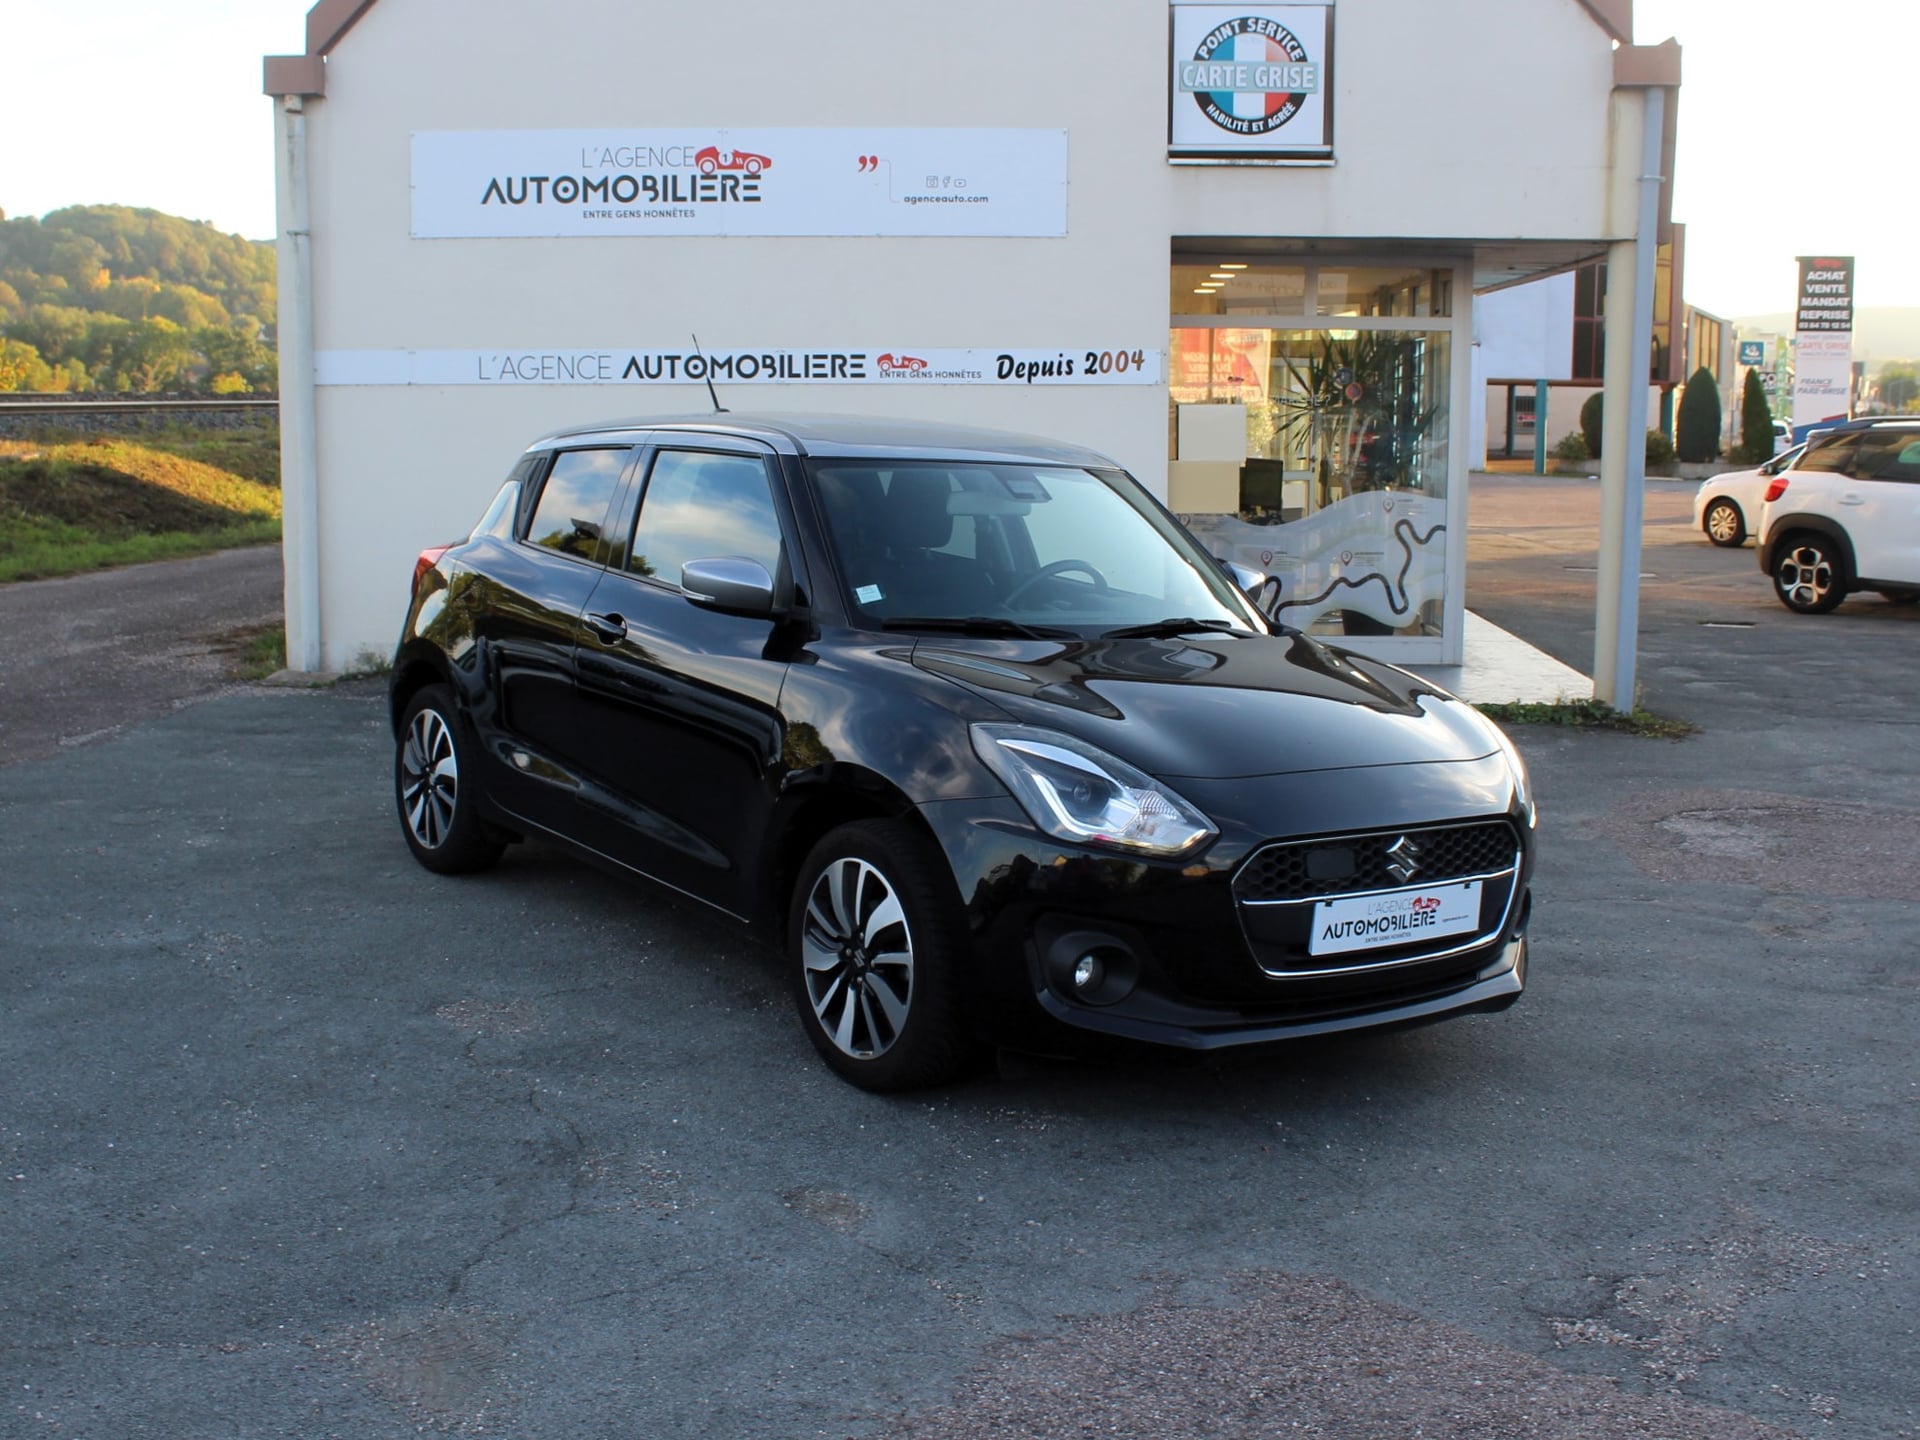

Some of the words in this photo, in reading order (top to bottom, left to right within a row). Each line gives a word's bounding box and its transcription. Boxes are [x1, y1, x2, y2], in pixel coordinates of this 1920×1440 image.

[1198, 19, 1242, 60] POINT
[1246, 17, 1304, 62] SERVICE
[1182, 64, 1248, 88] CARTE
[1254, 65, 1314, 89] GRISE
[1206, 103, 1249, 132] HABILITÉ
[1252, 120, 1265, 132] ET
[1267, 101, 1296, 129] AGRÉÉ
[581, 146, 696, 169] L'AGENCE
[903, 194, 989, 205] agenceauto.com
[583, 210, 613, 219] ENTRE
[615, 210, 641, 219] GENS
[643, 208, 696, 219] HONNÊTES
[1806, 270, 1847, 281] ACHAT
[1805, 284, 1847, 294] VENTE
[1801, 297, 1850, 307] MANDAT
[1800, 310, 1850, 320] REPRISE
[478, 355, 612, 380] L'AGENCE
[996, 353, 1074, 384] Depuis
[1084, 350, 1145, 375] 2004
[879, 369, 909, 379] ENTRE
[909, 369, 933, 379] GENS
[935, 368, 982, 379] HONNÊTES
[1797, 387, 1847, 395] PARE-BRISE
[1368, 897, 1413, 915] L'AGENCE
